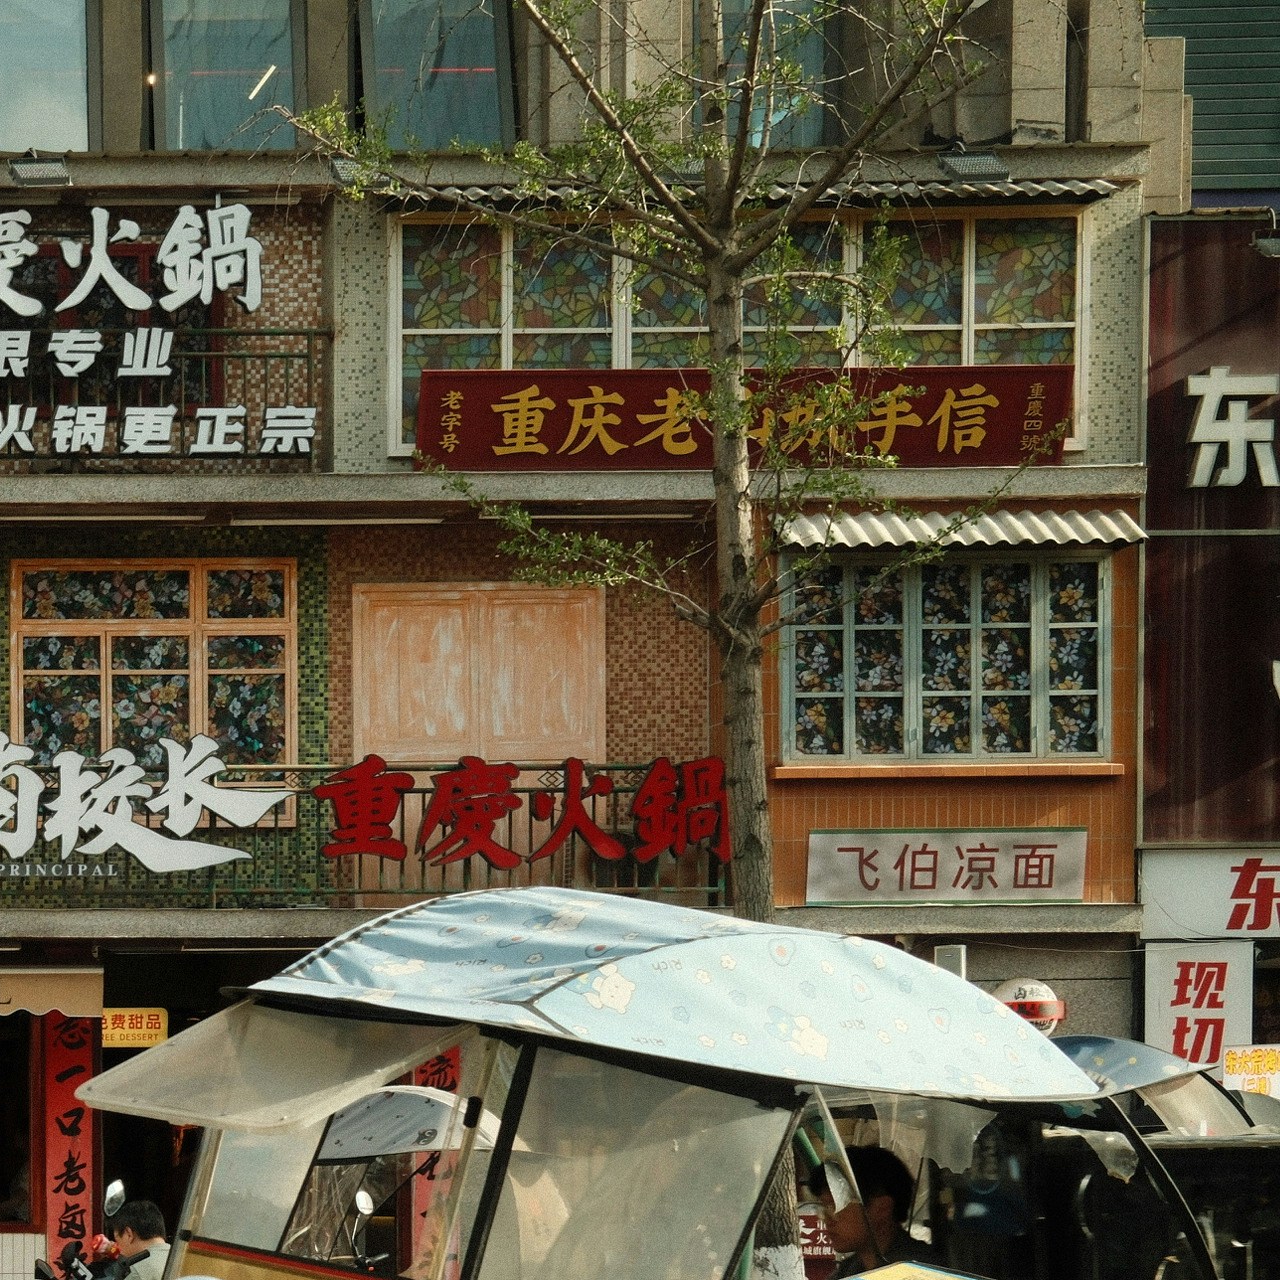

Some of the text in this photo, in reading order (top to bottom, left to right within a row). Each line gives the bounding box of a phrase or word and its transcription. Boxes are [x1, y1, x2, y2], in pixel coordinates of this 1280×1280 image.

[438, 389, 464, 453] 老字号
[311, 754, 732, 871] 重慶火鍋
[836, 842, 1058, 892] 飞伯凉面
[119, 1033, 159, 1041] DESSERT
